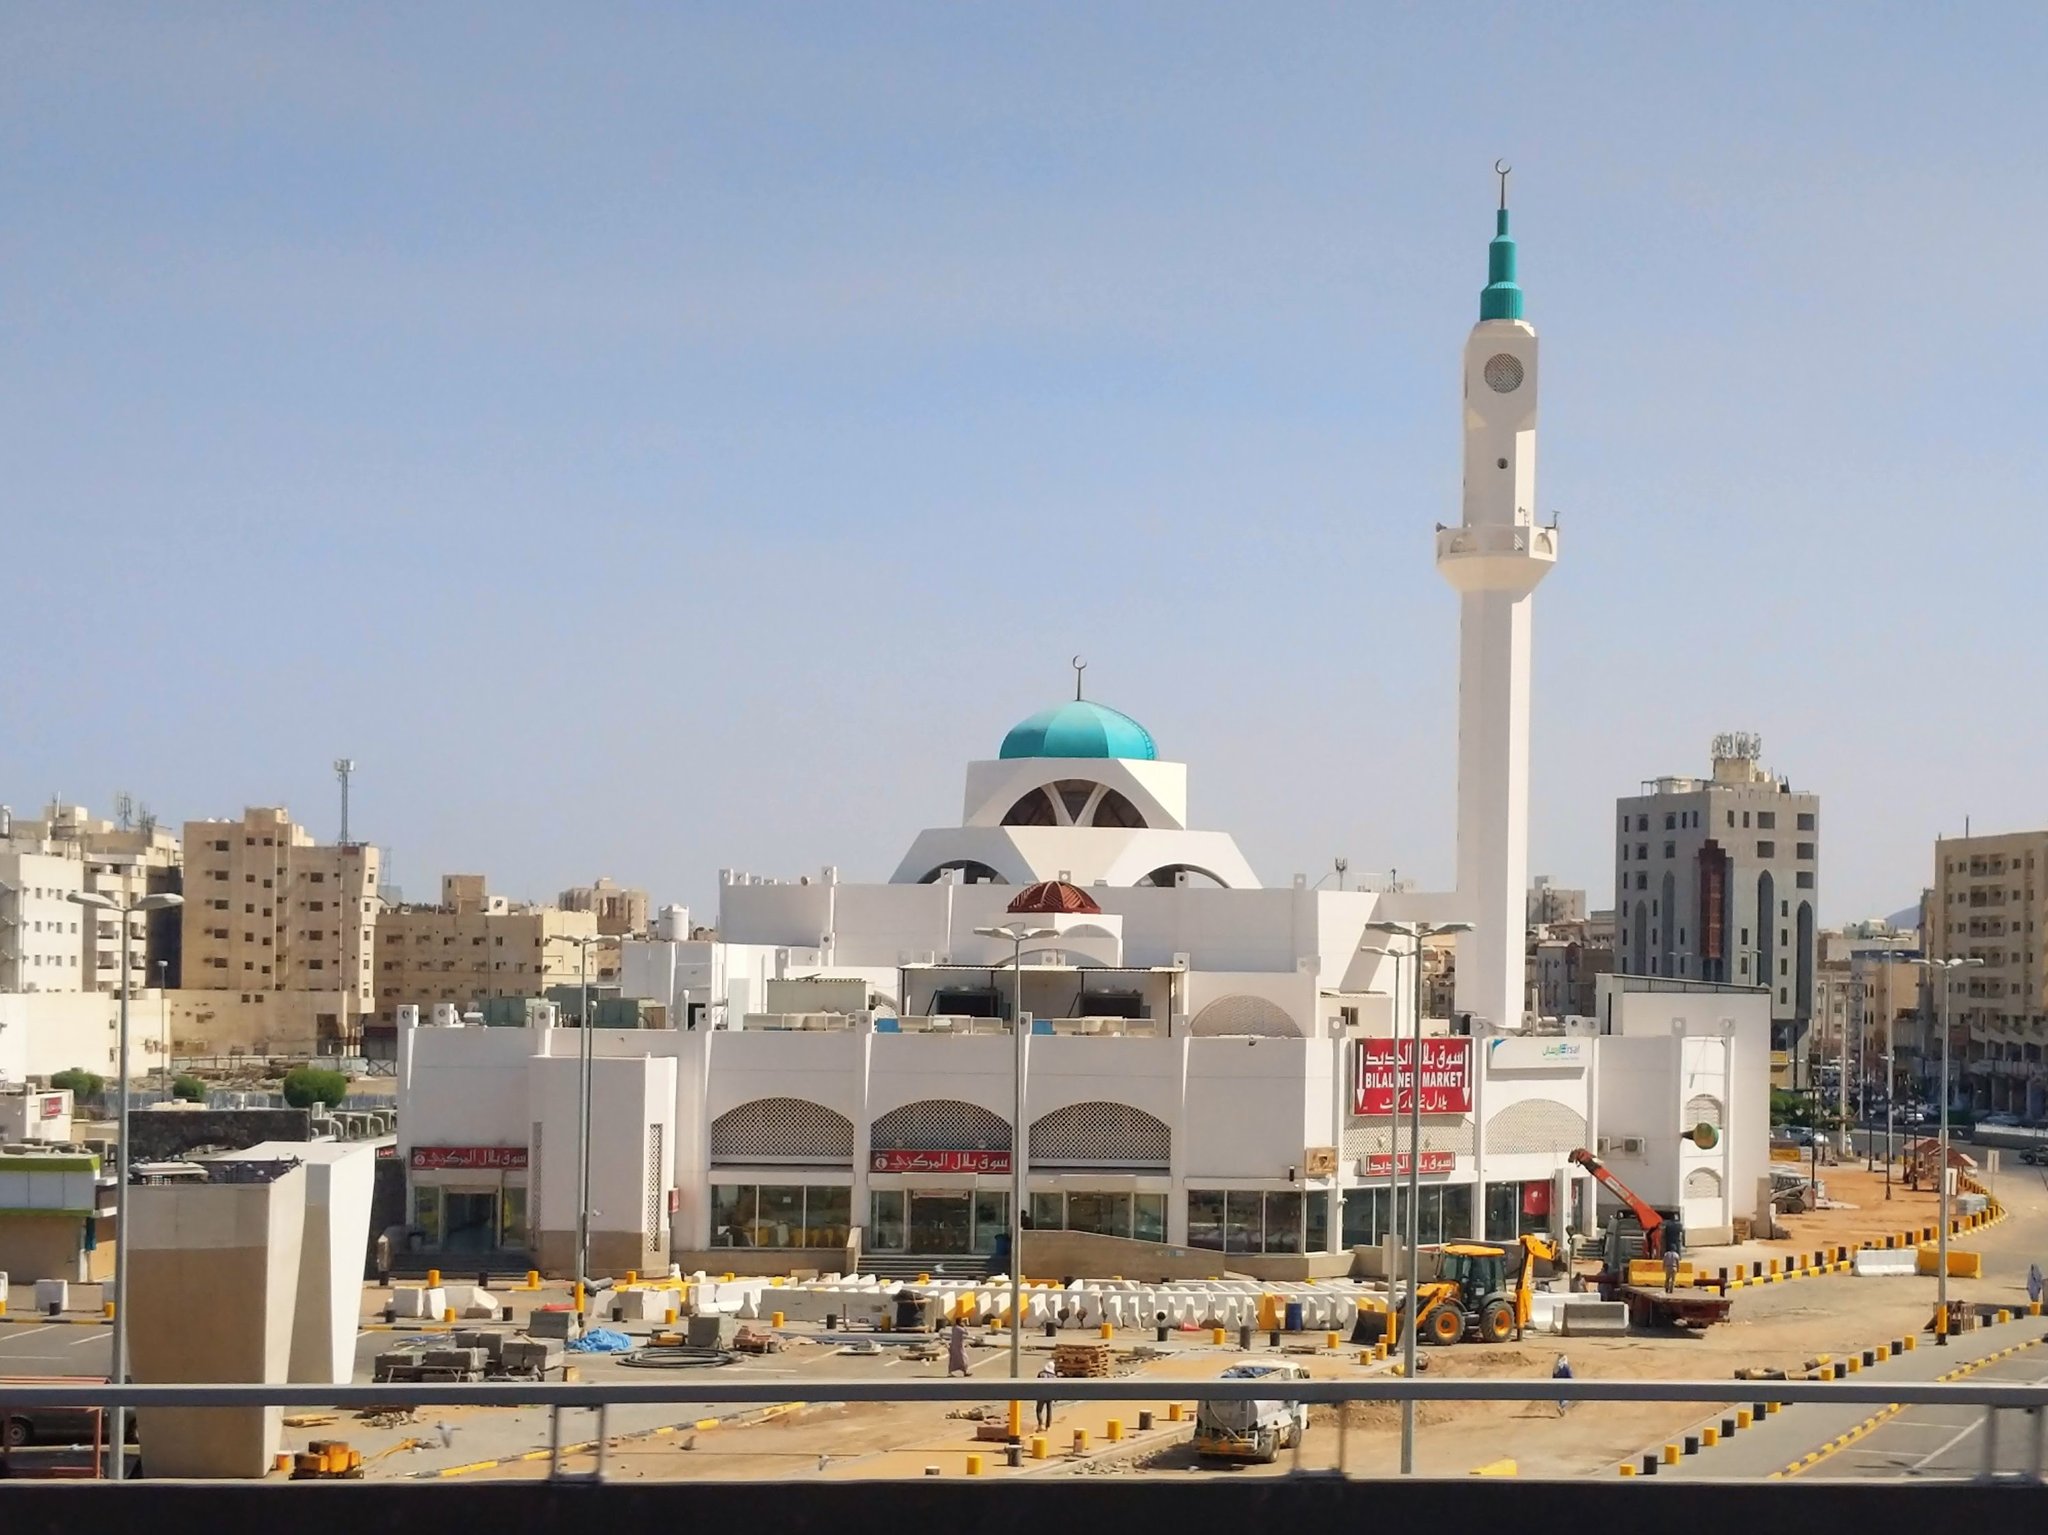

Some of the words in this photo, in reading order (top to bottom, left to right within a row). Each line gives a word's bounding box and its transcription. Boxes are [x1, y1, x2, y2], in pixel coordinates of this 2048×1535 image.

[1419, 1042, 1436, 1069] بلا
[1436, 1044, 1463, 1070] سوق
[1365, 1072, 1394, 1088] BILAL
[1422, 1071, 1463, 1087] MARKET
[479, 1149, 500, 1166] بلال
[501, 1150, 526, 1165] سوق
[890, 1152, 948, 1169] المركزي
[951, 1152, 977, 1169] بلال
[978, 1154, 1008, 1169] سوق
[1429, 1154, 1452, 1170] سوق
